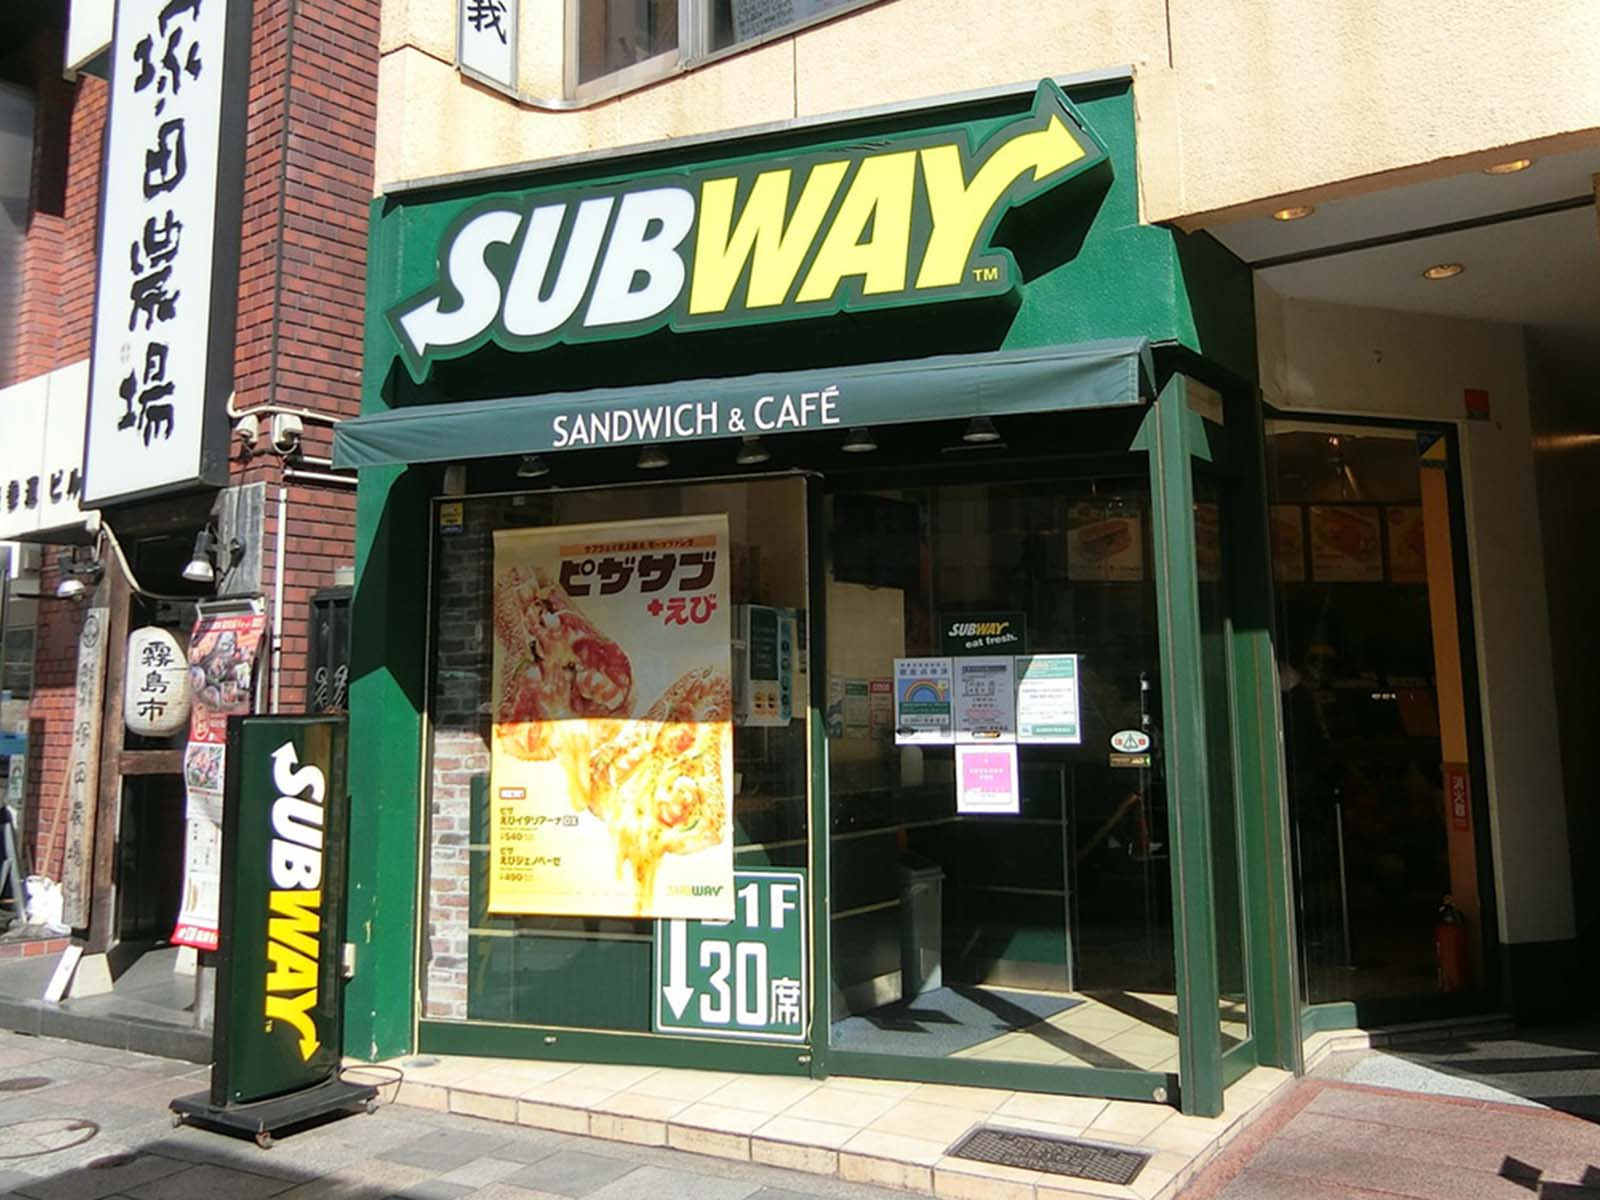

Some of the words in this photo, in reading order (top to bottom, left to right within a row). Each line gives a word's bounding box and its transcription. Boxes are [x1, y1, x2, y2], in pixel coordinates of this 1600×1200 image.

[400, 113, 1088, 358] SUBWAY
[972, 266, 998, 282] TM
[552, 401, 718, 448] SANDWICH
[728, 407, 746, 432] &
[754, 385, 840, 431] CAFÉ
[559, 550, 717, 597] ピザサブ
[948, 621, 1009, 637] SUBWAY
[965, 638, 984, 649] eat
[985, 633, 1018, 646] fresh.
[137, 641, 174, 722] 霧島市
[265, 741, 325, 1061] SUBWAY
[700, 939, 801, 1026] 30席
